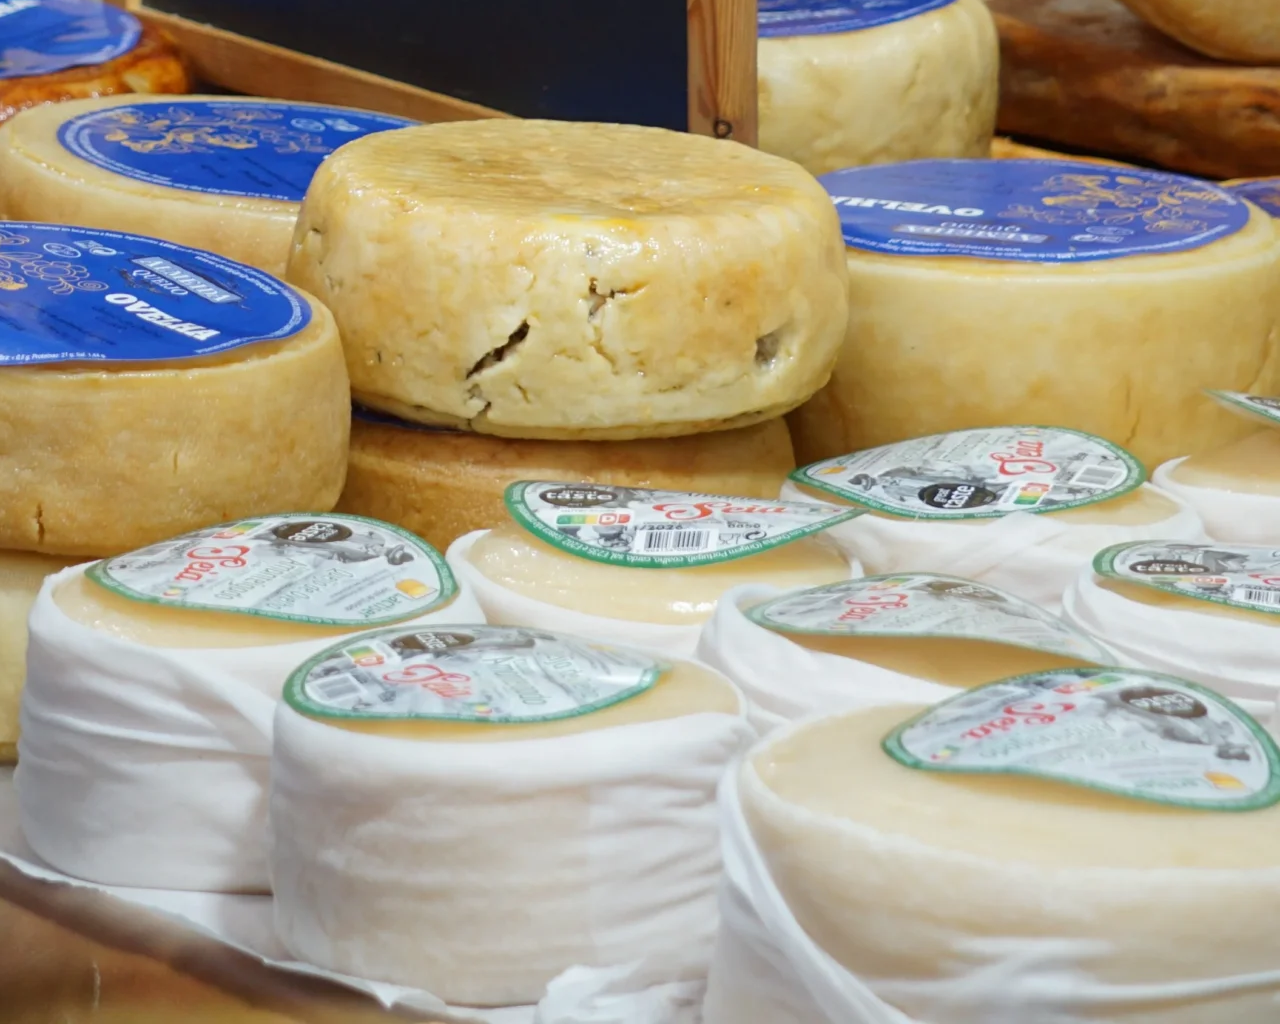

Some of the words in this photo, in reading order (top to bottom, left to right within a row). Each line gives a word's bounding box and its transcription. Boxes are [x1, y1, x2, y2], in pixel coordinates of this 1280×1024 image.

[132, 269, 188, 296] QUEIJO
[141, 257, 231, 302] ALMEIDA
[105, 293, 220, 341] OVELHA
[990, 440, 1058, 476] Seia
[545, 491, 614, 501] taste
[942, 484, 976, 509] taste
[652, 501, 786, 521] Seia
[288, 522, 333, 541] taste
[174, 544, 251, 582] Seia
[1136, 564, 1205, 574] taste
[838, 593, 909, 621] Seia
[382, 664, 473, 699] Seia
[960, 702, 1077, 740] Seia
